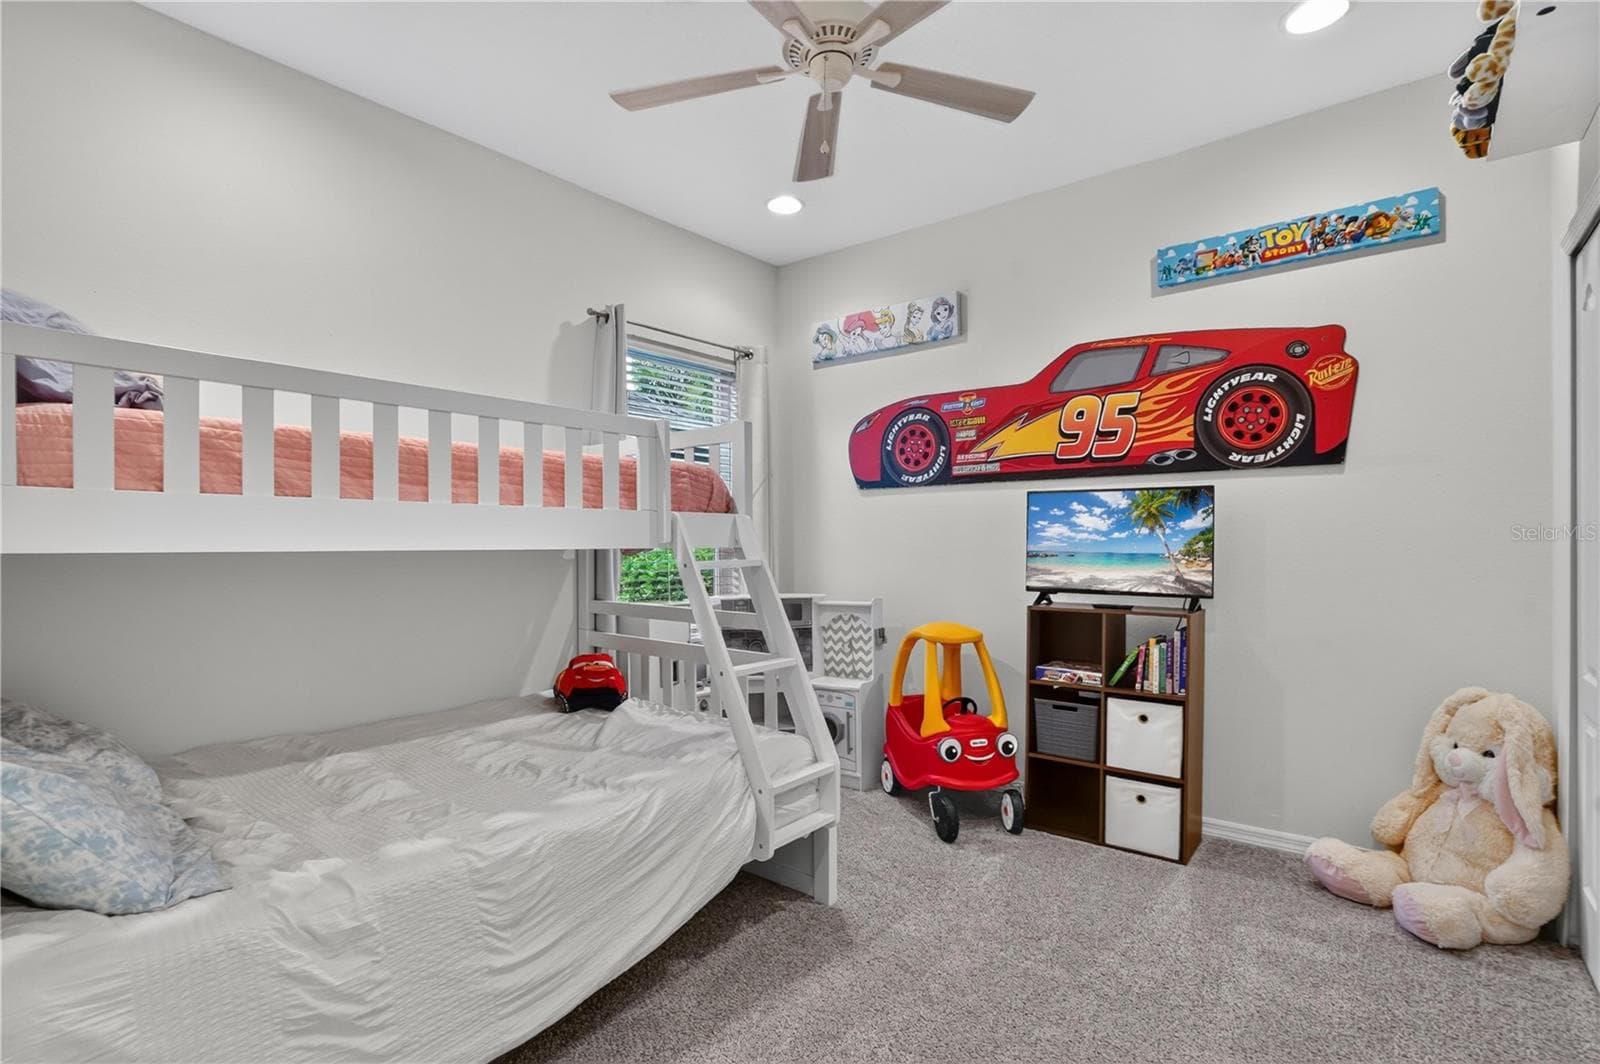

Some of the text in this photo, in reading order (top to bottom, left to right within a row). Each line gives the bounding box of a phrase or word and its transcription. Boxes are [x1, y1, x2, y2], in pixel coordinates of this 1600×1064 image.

[1260, 222, 1309, 248] TOY
[1264, 243, 1305, 258] STORY
[1203, 372, 1278, 422] LIGHTYEAR
[886, 413, 931, 451] LIGHTYEAR
[1056, 391, 1141, 459] 95
[1228, 413, 1306, 464] LIGHTYEAR
